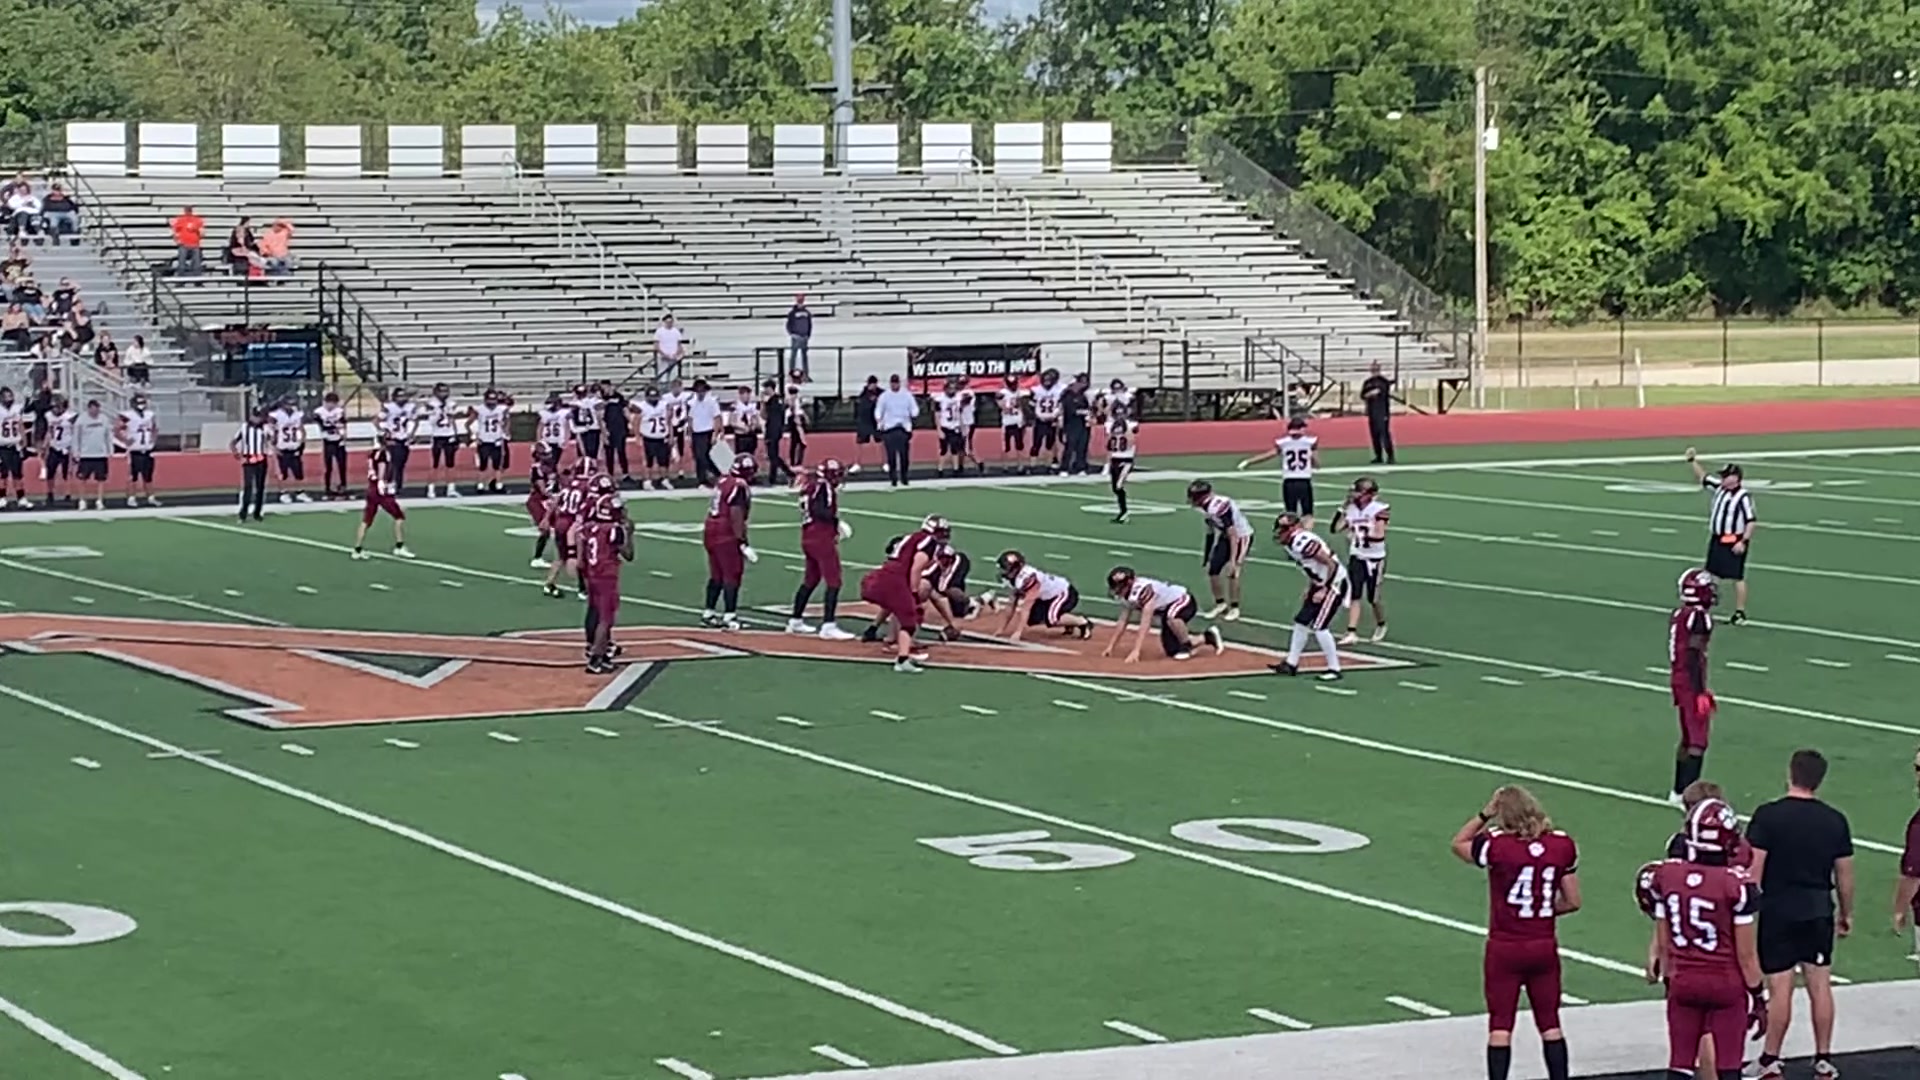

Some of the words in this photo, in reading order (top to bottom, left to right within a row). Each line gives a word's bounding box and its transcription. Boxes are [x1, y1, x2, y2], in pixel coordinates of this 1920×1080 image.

[969, 360, 986, 375] TO
[650, 417, 666, 433] 75
[1286, 450, 1308, 471] 25
[558, 487, 582, 515] 30
[587, 537, 599, 565] 3
[1507, 865, 1556, 919] 41
[1664, 892, 1720, 953] 15
